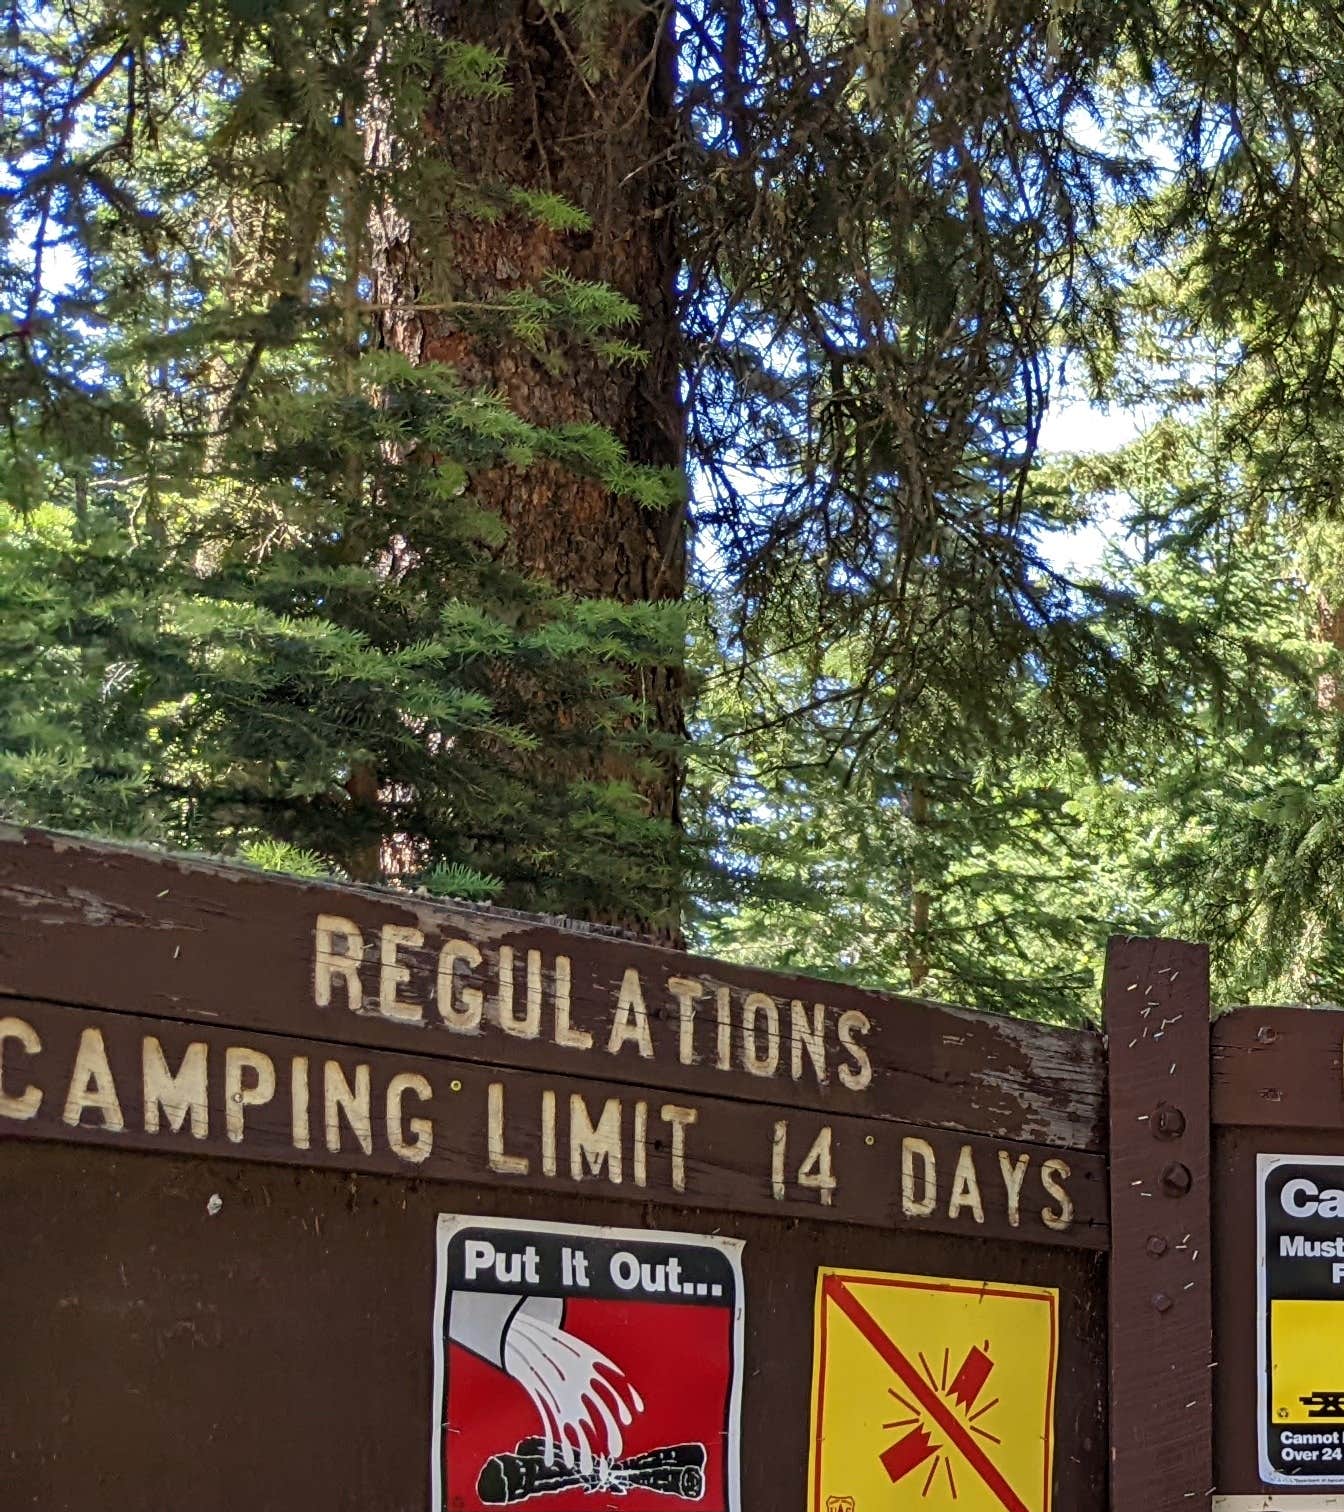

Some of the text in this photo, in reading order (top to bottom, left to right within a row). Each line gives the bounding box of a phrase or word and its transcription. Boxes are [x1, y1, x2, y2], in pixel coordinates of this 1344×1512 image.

[314, 913, 874, 1092] REGULATIONS
[0, 1017, 1074, 1231] CAMPING LIMIT 14 DAYS
[464, 1240, 723, 1297] Put It Out...
[1281, 1431, 1339, 1444] Cannot
[1282, 1448, 1318, 1461] Over
[1322, 1448, 1342, 1460] 24
